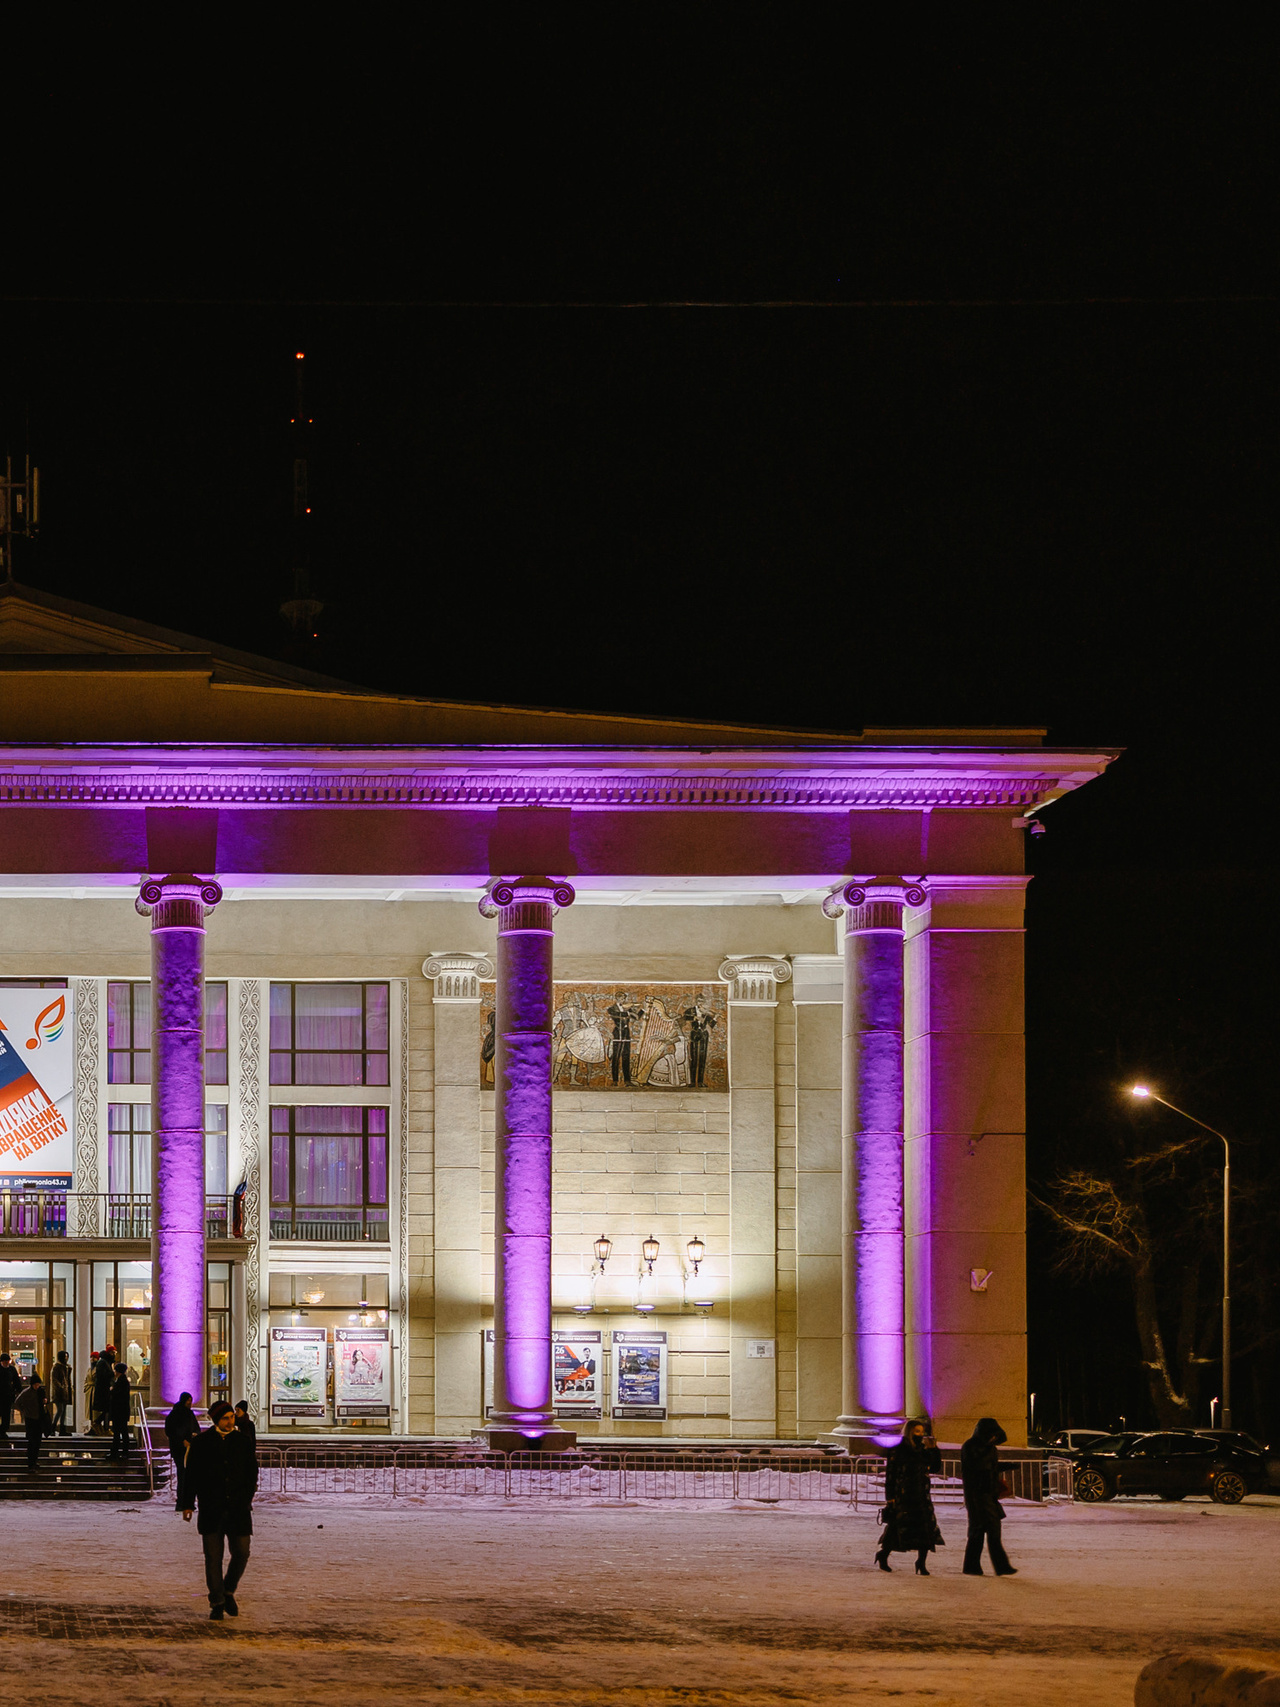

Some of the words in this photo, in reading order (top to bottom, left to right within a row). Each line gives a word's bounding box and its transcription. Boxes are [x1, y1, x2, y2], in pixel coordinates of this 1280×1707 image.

[12, 1142, 34, 1161] НА
[29, 1117, 68, 1151] ВЯТКУ
[555, 1346, 565, 1354] 26
